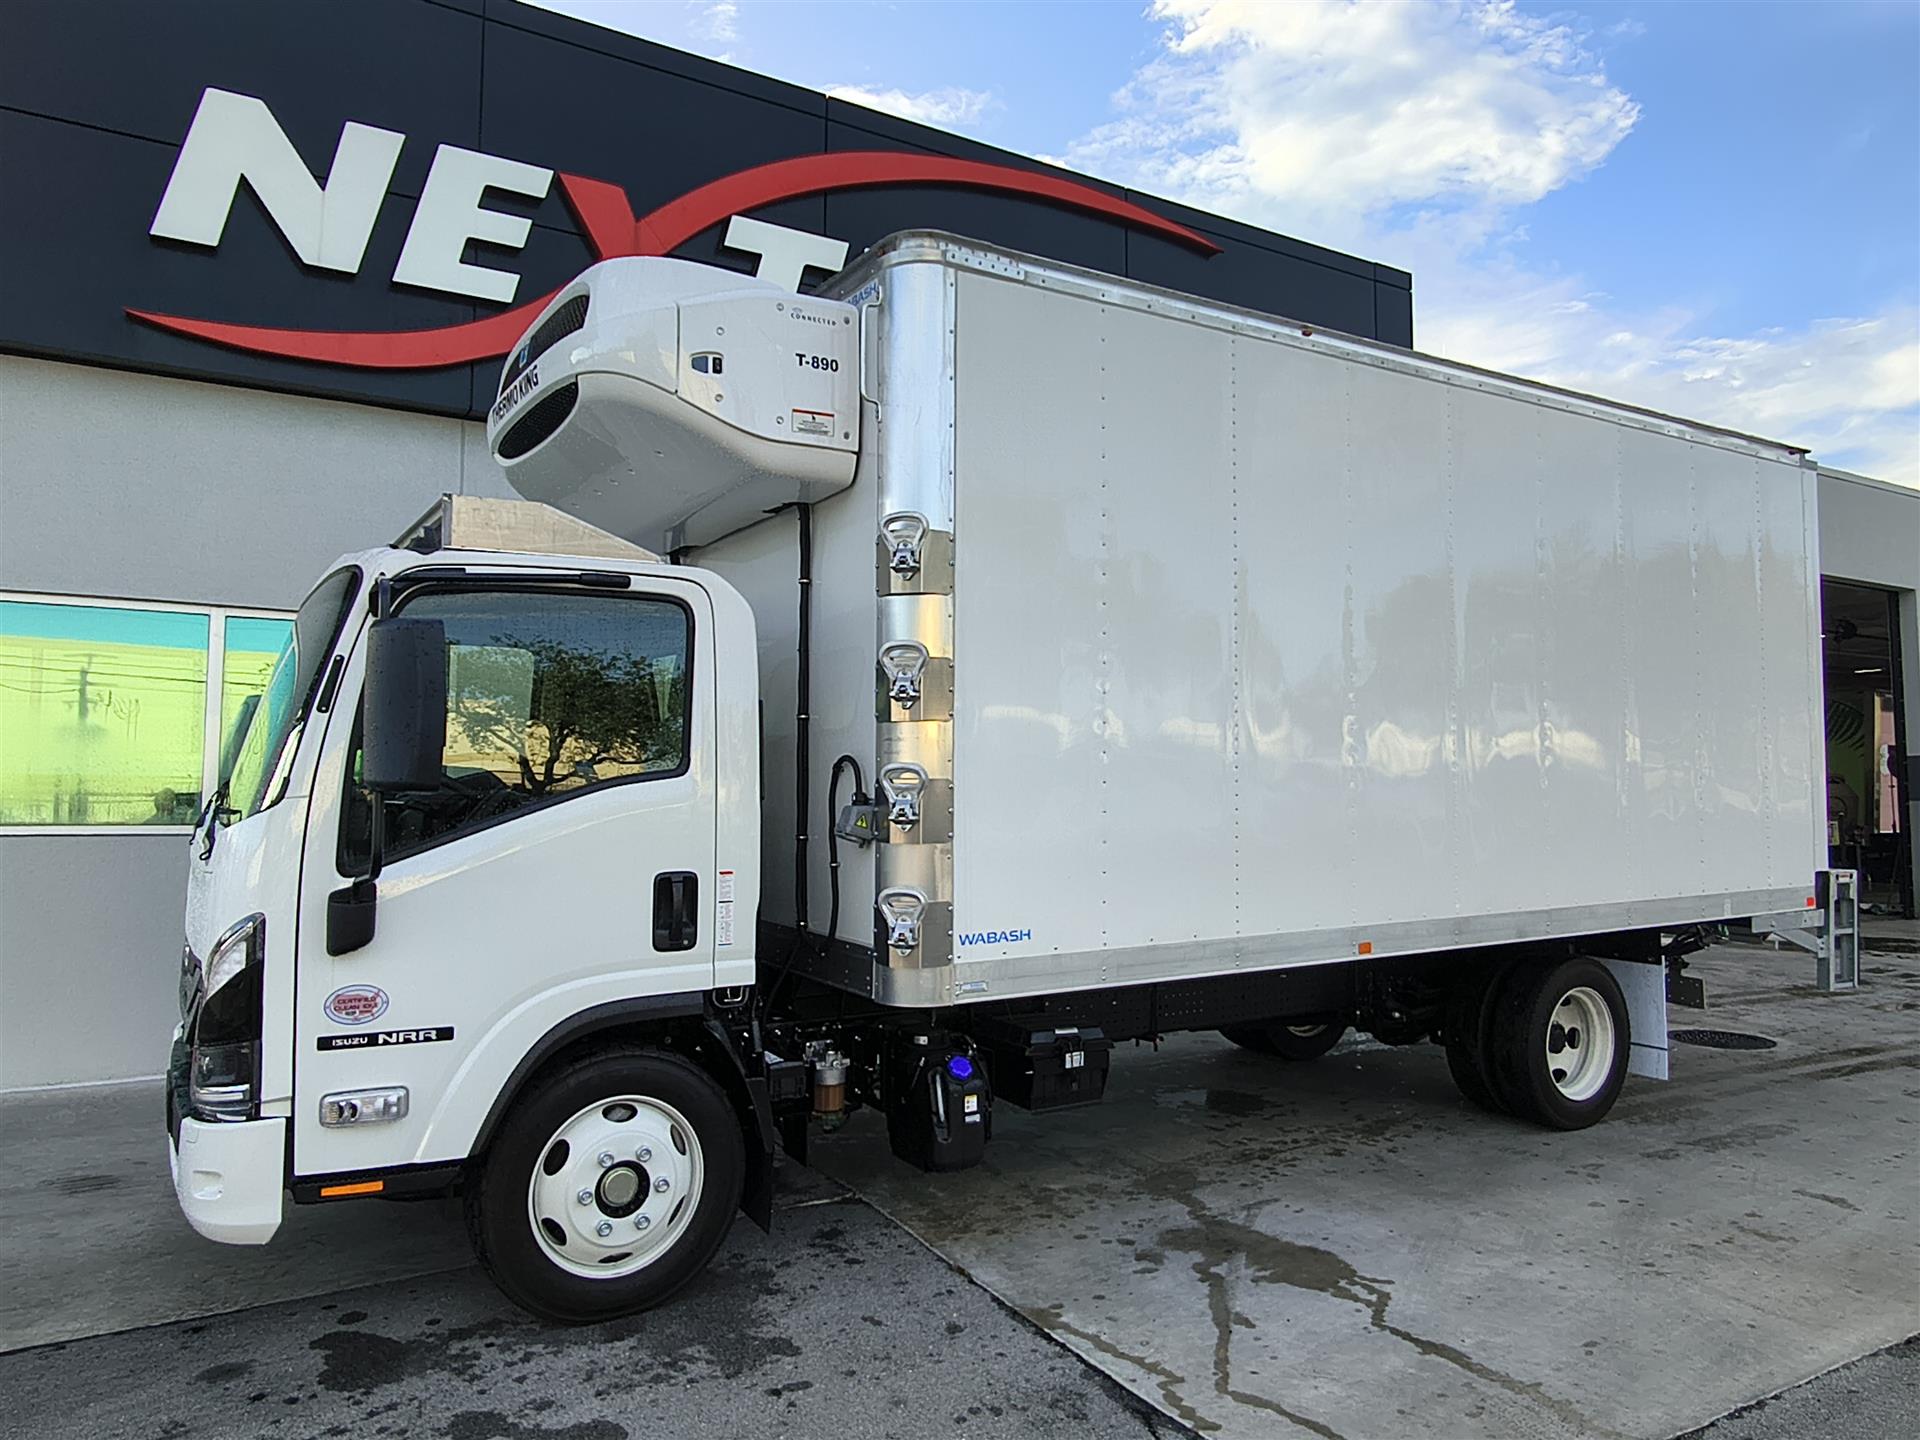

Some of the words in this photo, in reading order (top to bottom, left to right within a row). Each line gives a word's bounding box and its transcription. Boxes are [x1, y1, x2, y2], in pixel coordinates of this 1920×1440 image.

[790, 312, 837, 326] CONNECTED
[795, 353, 839, 372] T-890
[492, 385, 519, 427] THERMO
[519, 364, 539, 399] KING
[958, 929, 1031, 946] WABASH
[332, 1037, 368, 1047] ISUZU
[378, 1029, 437, 1045] NRR
